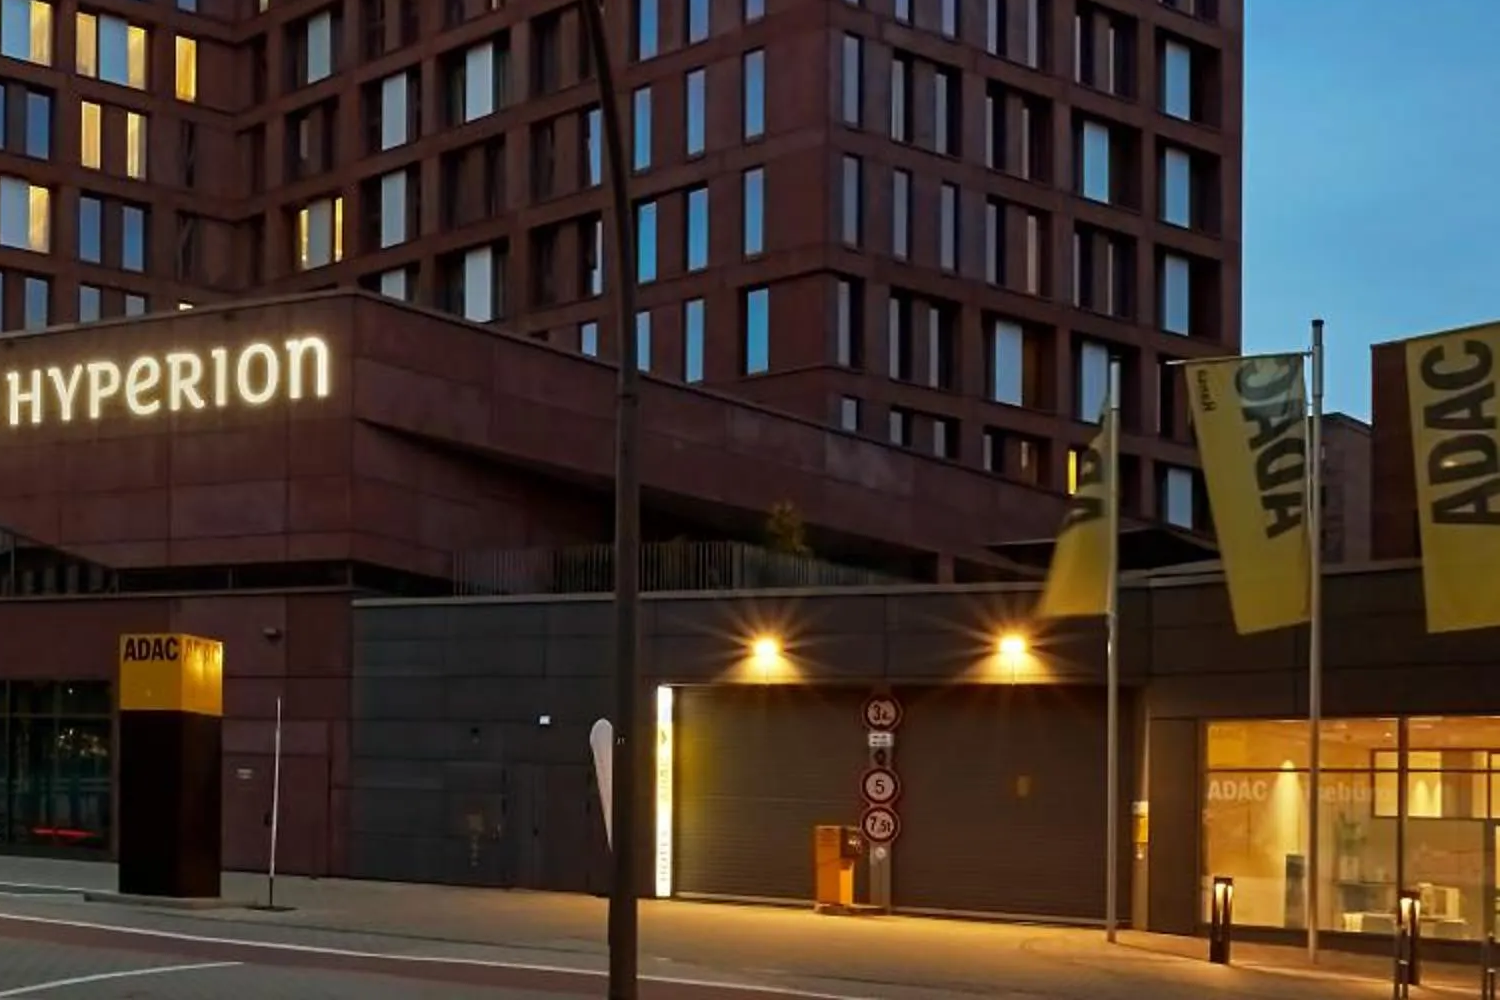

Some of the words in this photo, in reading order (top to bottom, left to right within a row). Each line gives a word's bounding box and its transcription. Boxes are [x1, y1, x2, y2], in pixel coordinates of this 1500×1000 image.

[1420, 338, 1500, 525] ADAC
[123, 636, 179, 662] ADAC
[875, 779, 885, 795] 5
[1208, 779, 1269, 802] ADAC
